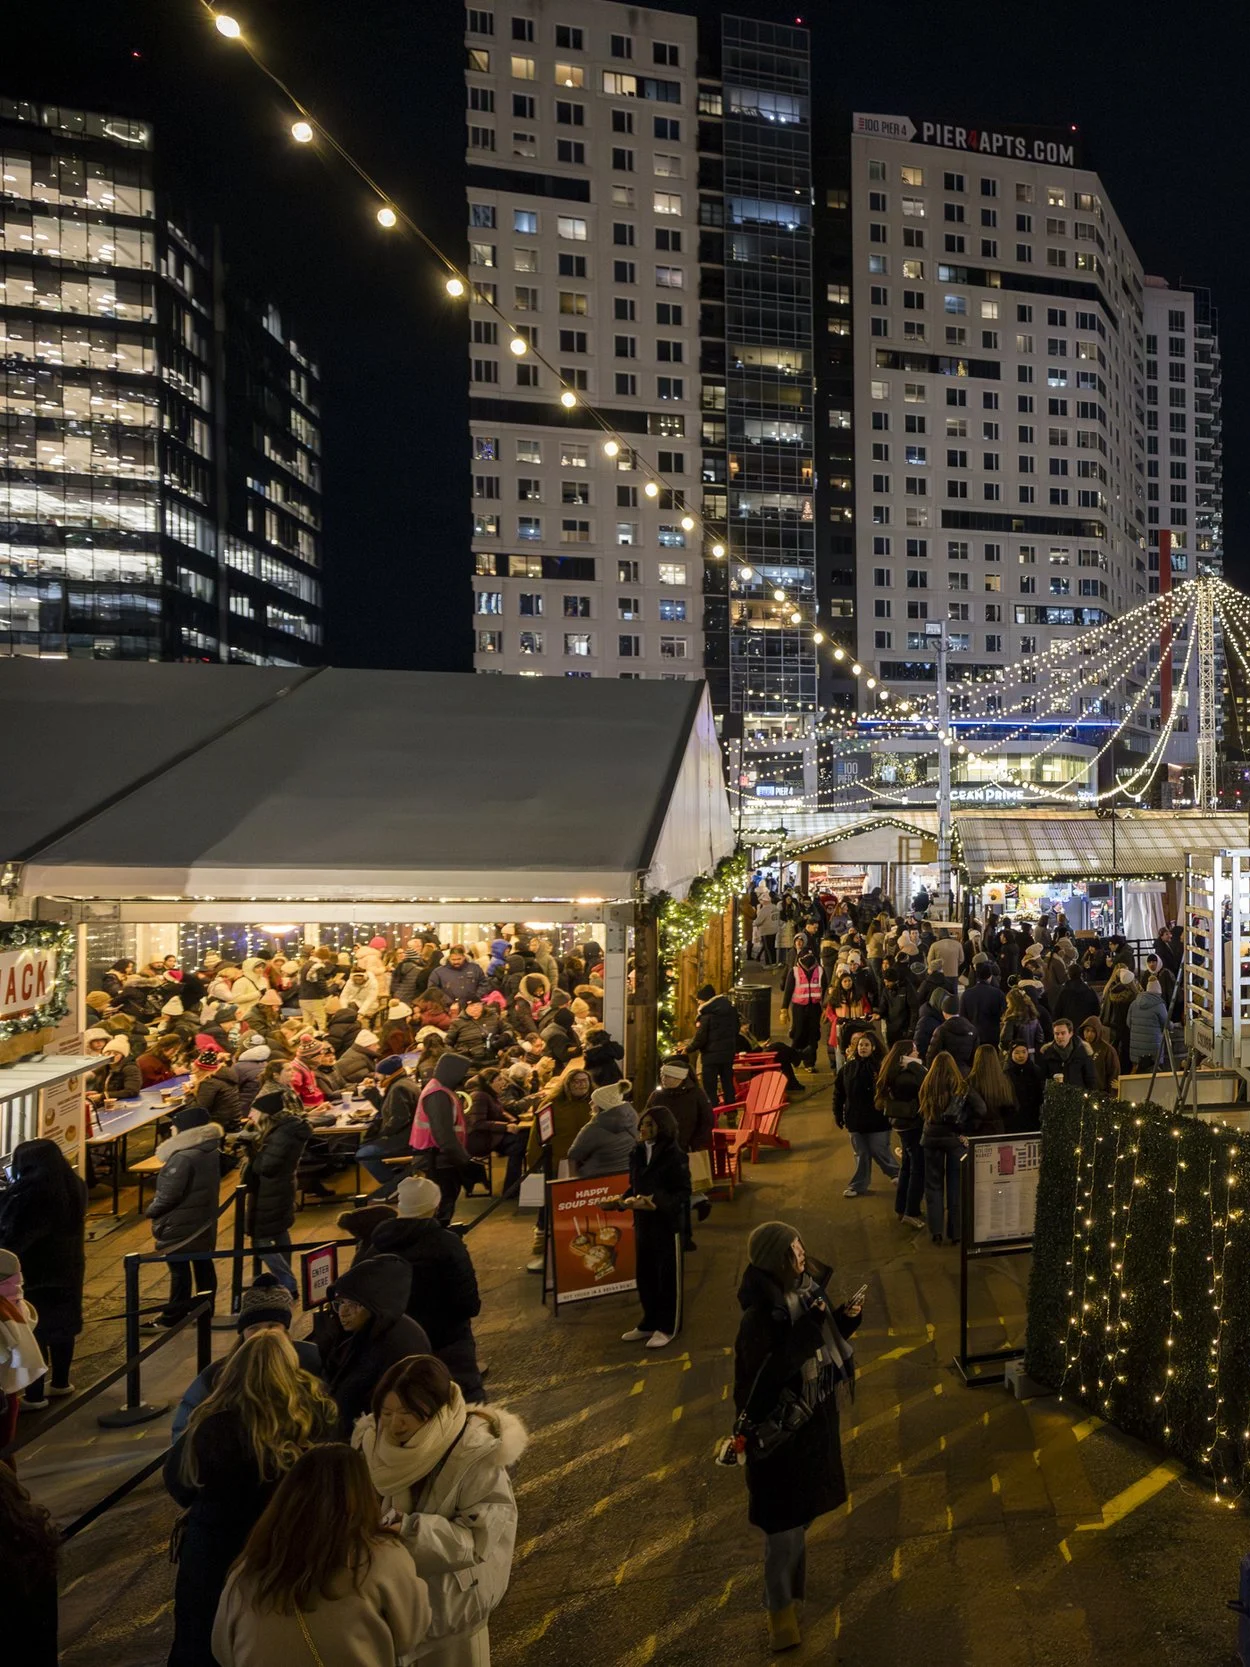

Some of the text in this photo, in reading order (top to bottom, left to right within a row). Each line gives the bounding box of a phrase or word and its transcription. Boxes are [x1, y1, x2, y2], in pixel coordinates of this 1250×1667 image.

[882, 121, 900, 135] PIER
[901, 124, 907, 136] 4
[923, 121, 1075, 166] PIER4APTS.COM
[986, 789, 1024, 800] PRIME
[0, 959, 49, 1006] ACK
[576, 1187, 609, 1199] HAPPY
[558, 1200, 587, 1211] SOUP
[312, 1264, 329, 1278] ENTER
[314, 1277, 329, 1289] HERE
